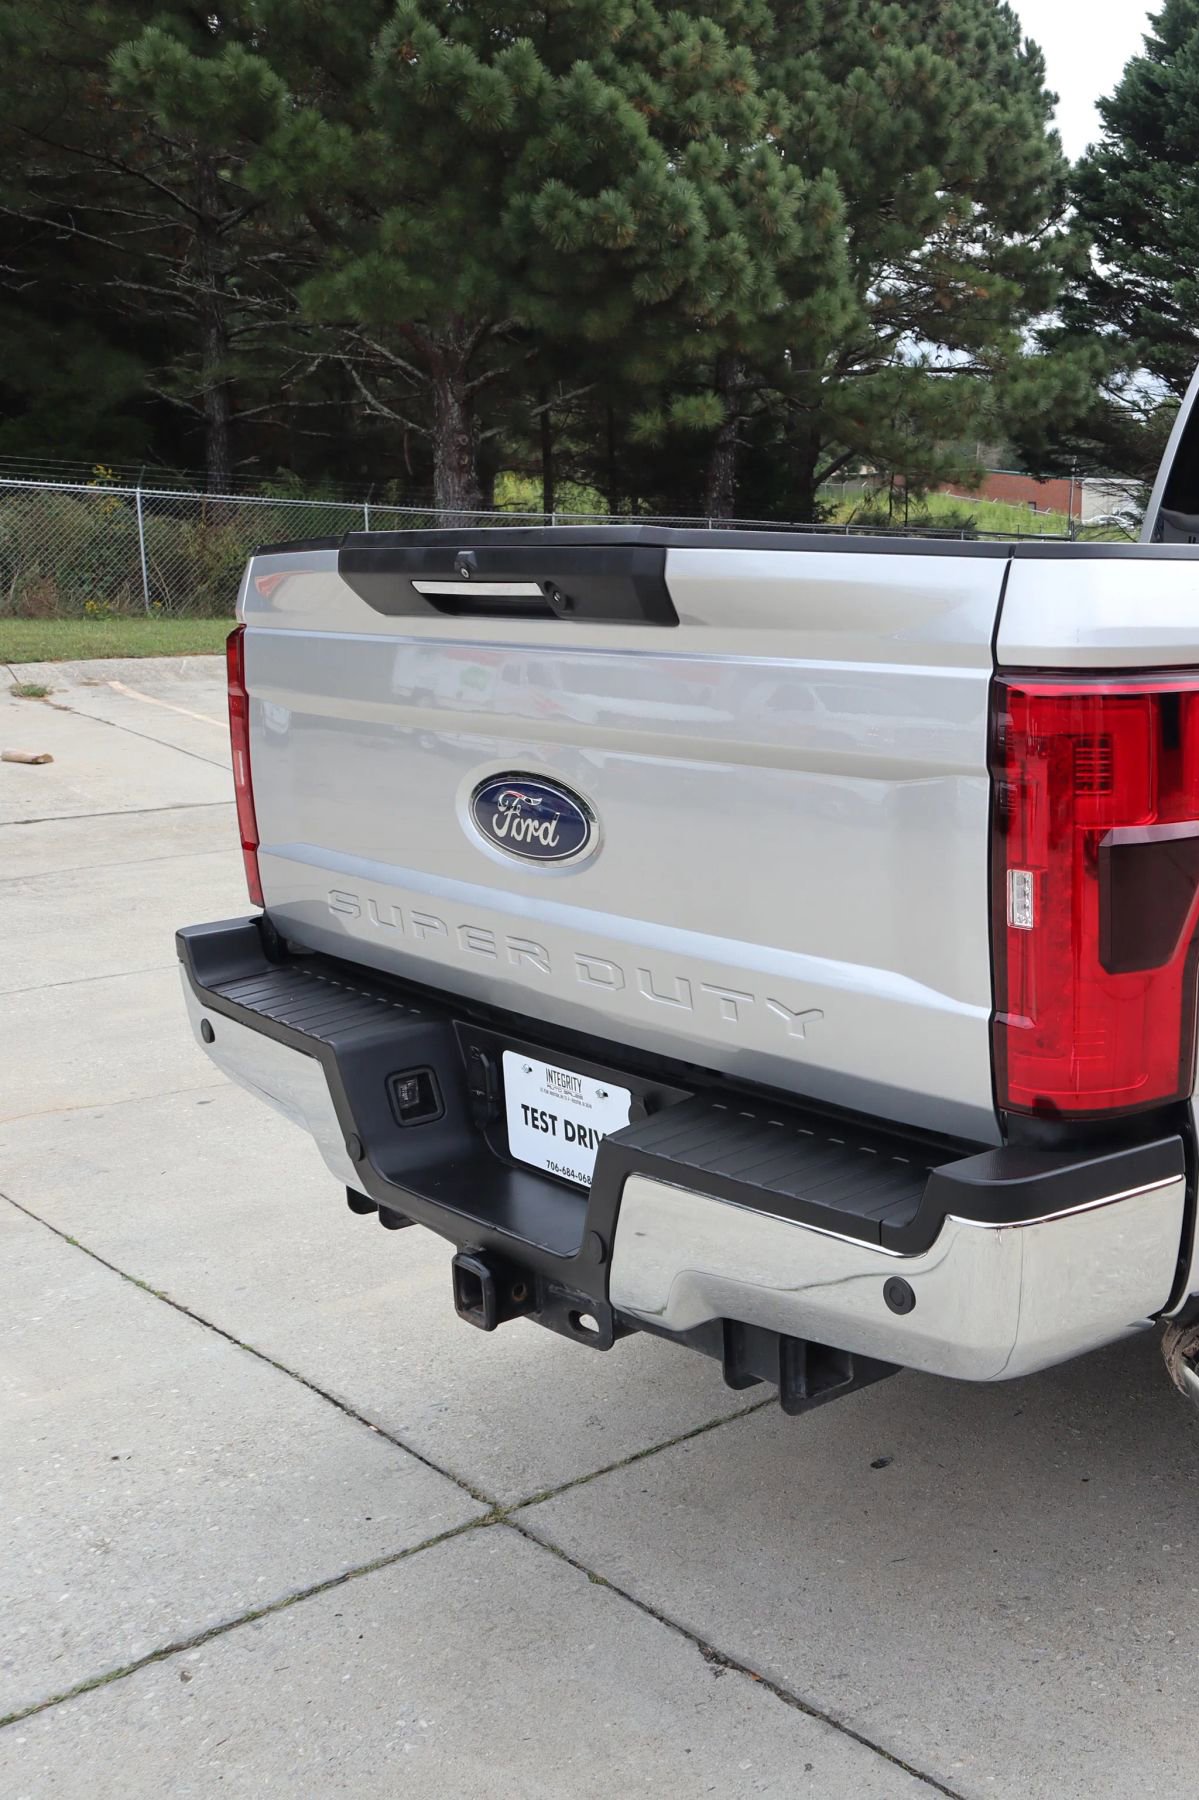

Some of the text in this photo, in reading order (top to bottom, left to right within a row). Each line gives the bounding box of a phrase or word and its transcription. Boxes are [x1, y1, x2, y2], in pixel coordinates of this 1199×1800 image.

[492, 790, 560, 847] Ford
[327, 888, 825, 1040] SUPER DUTY
[545, 1067, 582, 1094] INTEGRITY
[520, 1103, 607, 1151] TEST DRIV
[546, 1159, 592, 1185] 706-684-068
